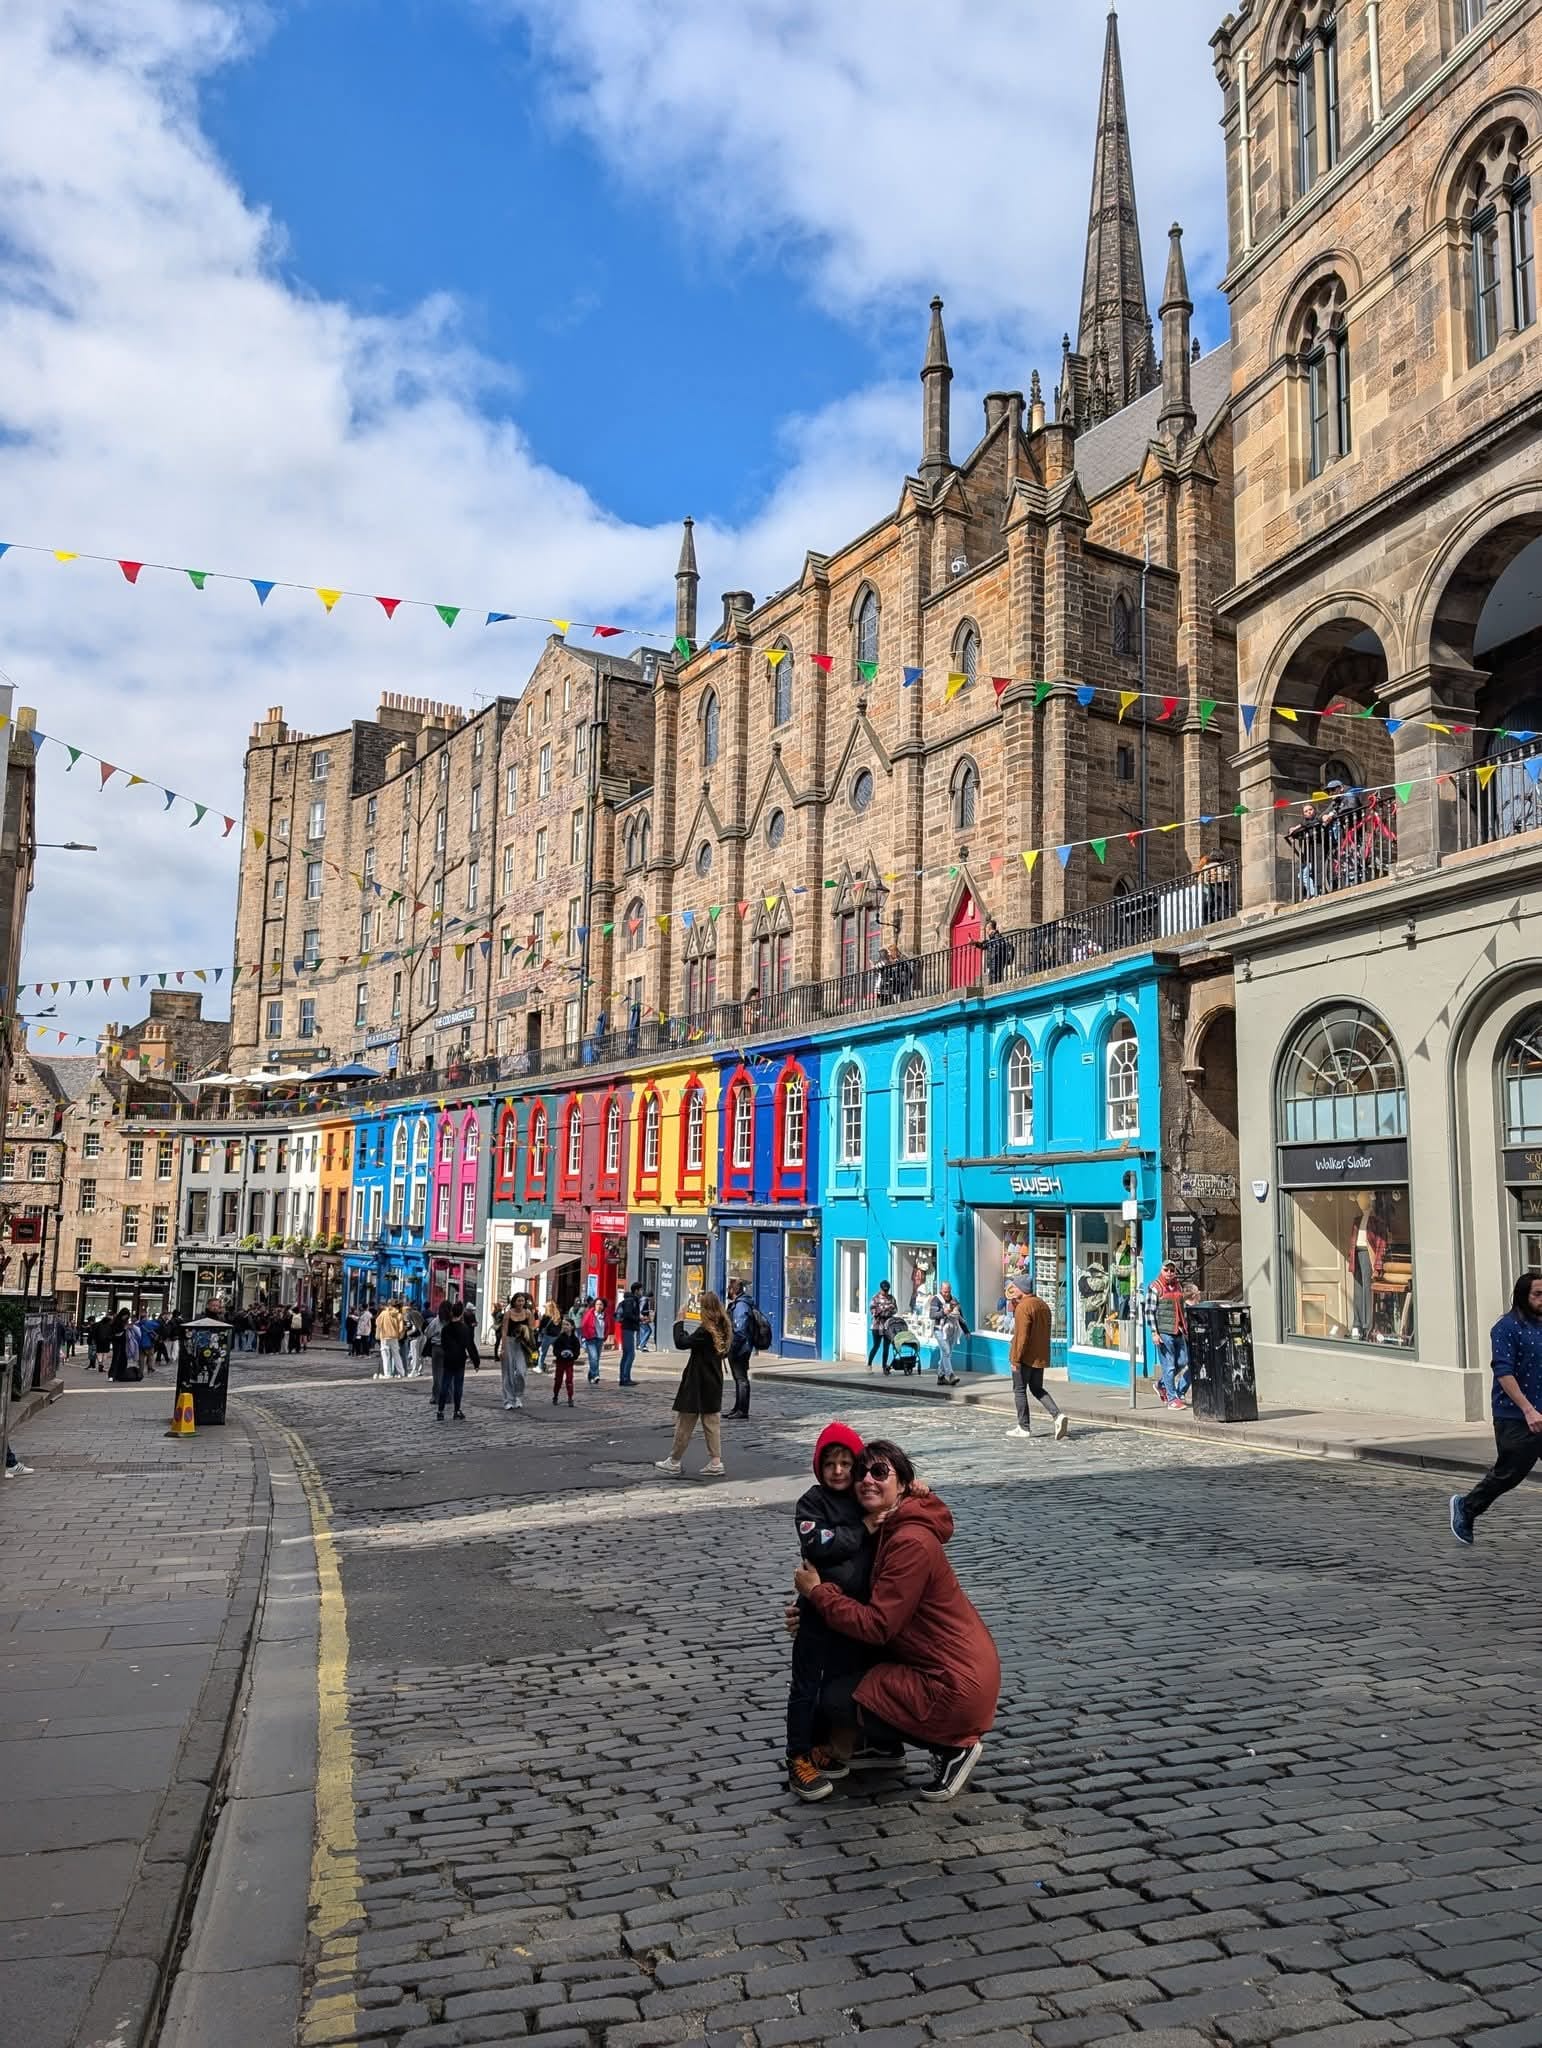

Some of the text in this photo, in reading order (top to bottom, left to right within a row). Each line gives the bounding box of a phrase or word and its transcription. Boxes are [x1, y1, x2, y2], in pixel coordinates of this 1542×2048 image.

[1315, 1155, 1373, 1171] Walker Slater
[1010, 1176, 1062, 1193] SWISH
[642, 1217, 698, 1228] THE WHISKY SHOP
